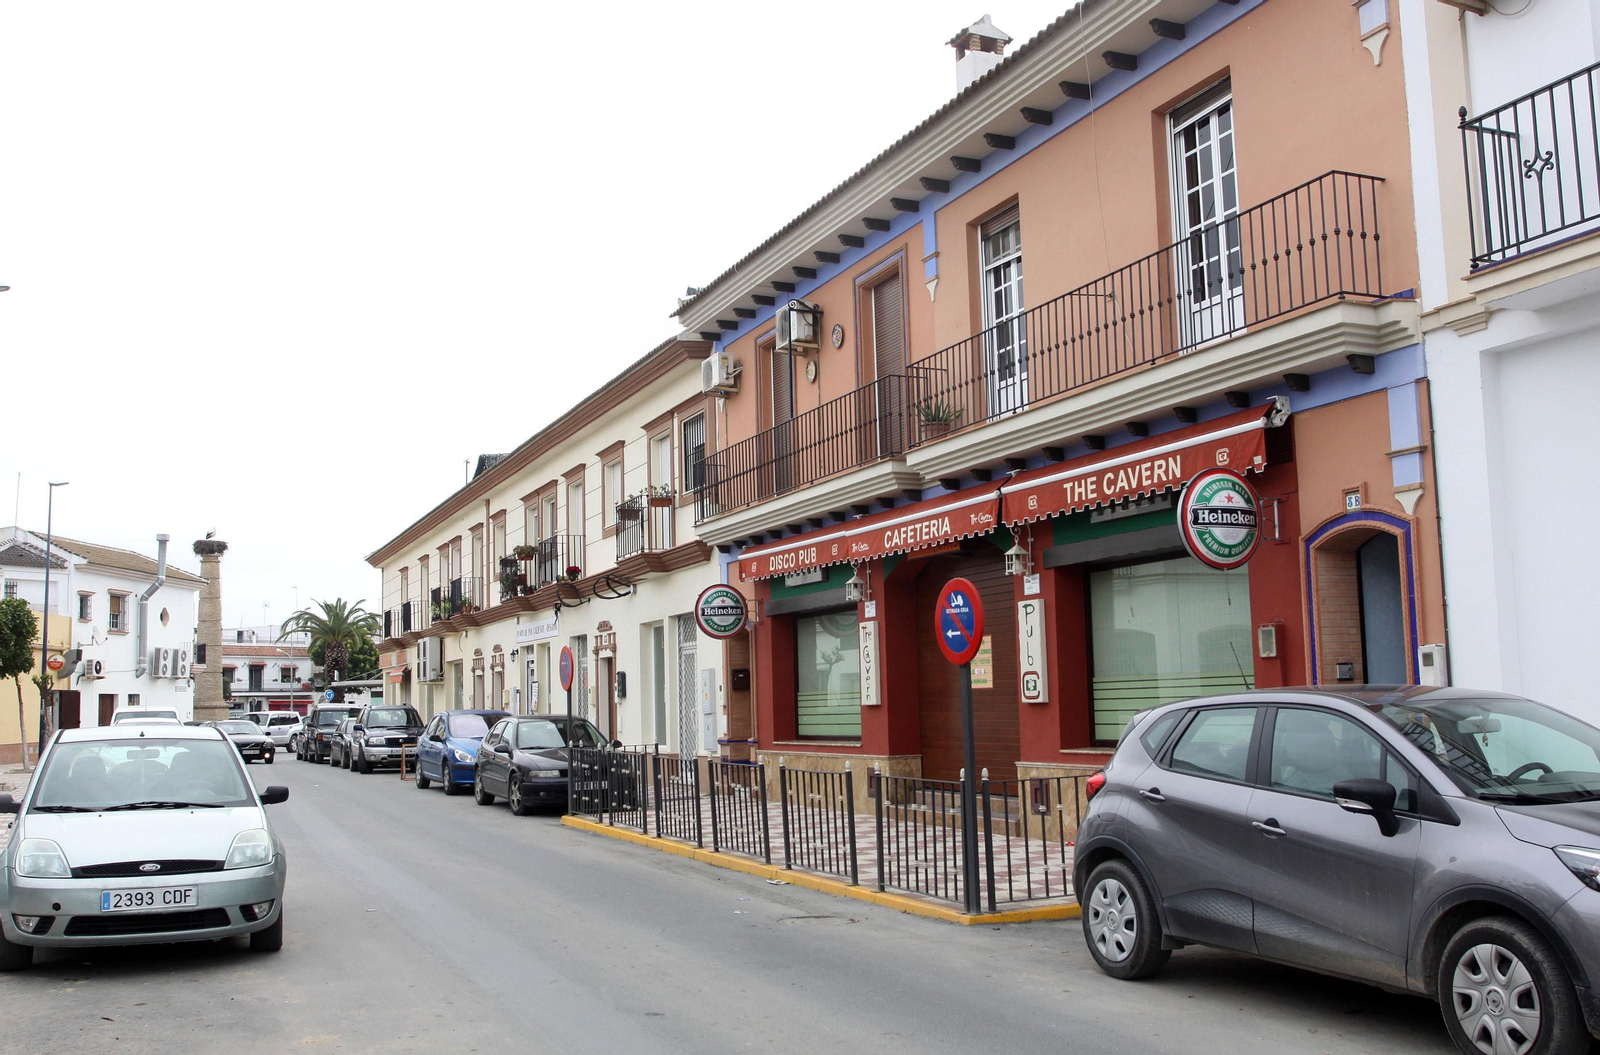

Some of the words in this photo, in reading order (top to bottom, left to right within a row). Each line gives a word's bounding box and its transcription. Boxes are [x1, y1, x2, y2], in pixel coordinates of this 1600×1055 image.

[1063, 476, 1097, 504] THE
[1103, 454, 1181, 495] CAVERN
[1202, 480, 1233, 498] HEINEKEN
[1235, 484, 1249, 500] BEER
[1197, 509, 1256, 525] Heineken
[884, 516, 951, 549] CAFETERIA
[1202, 532, 1230, 555] PREMIUM
[1231, 534, 1252, 555] QUALITY
[769, 552, 796, 572] DISCO
[798, 547, 817, 565] PUB
[704, 606, 742, 616] Heineken
[707, 619, 725, 631] PREMIUM
[1022, 603, 1036, 667] Pub
[113, 891, 155, 908] 2393
[163, 888, 193, 905] CDF
